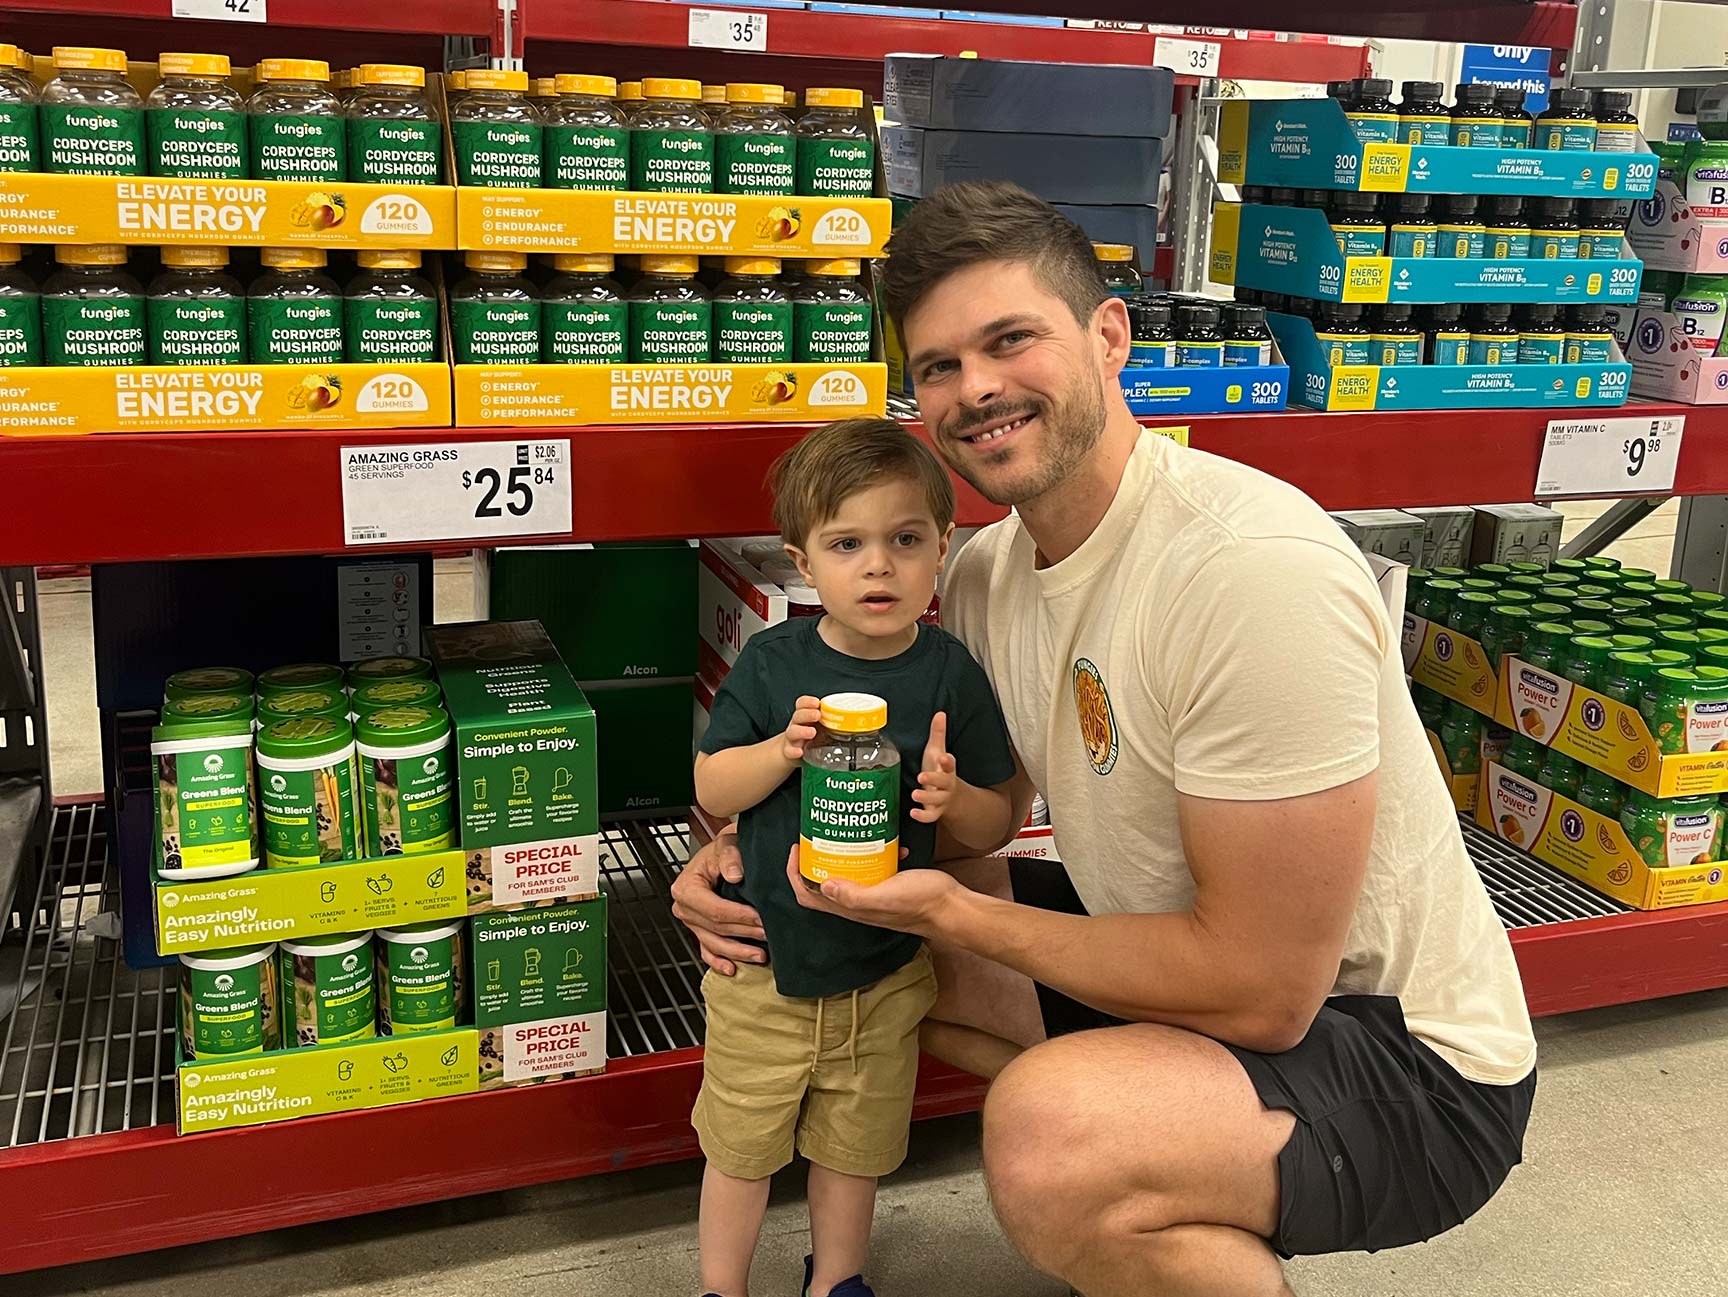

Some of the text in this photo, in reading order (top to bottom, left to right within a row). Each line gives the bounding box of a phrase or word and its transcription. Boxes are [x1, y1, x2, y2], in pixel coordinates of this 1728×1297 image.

[1522, 80, 1545, 94] this
[66, 115, 118, 130] fungies
[380, 127, 424, 142] fungies
[488, 130, 530, 145] fungies
[53, 137, 133, 152] CORDYCEPS
[662, 139, 702, 153] fungies
[52, 150, 136, 166] MUSHROOM
[366, 149, 435, 162] CORDYCEPS
[473, 152, 539, 165] CORDYCEPS
[1369, 156, 1402, 167] ENERGY
[364, 162, 437, 176] MUSHROOM
[471, 164, 540, 178] MUSHROOM
[648, 159, 710, 171] CORDYCEPS
[1369, 165, 1401, 175] HEALTH
[1496, 164, 1530, 175] VITAMIN
[1628, 163, 1653, 179] 300
[646, 171, 711, 184] MUSHROOM
[117, 184, 266, 202] ELEVATE YOUR
[1625, 182, 1650, 192] TABLETS
[375, 202, 417, 220] 120
[614, 200, 737, 217] ELEVATE YOUR
[118, 203, 267, 231] ENERGY
[824, 214, 860, 232] 120
[376, 222, 418, 231] GUMMIES
[614, 217, 736, 242] ENERGY
[825, 234, 859, 242] GUMMIES
[1350, 268, 1383, 278] ENERGY
[1479, 273, 1513, 282] VITAMIN
[1610, 268, 1637, 283] 300
[1350, 277, 1382, 287] HEALTH
[1609, 287, 1634, 296] TABLETS
[81, 306, 130, 322] fungies
[656, 310, 698, 324] fungies
[67, 329, 142, 341] CORDYCEPS
[644, 330, 707, 341] CORDYCEPS
[65, 340, 144, 354] MUSHROOM
[642, 341, 708, 353] MUSHROOM
[116, 373, 262, 388] ELEVATE YOUR
[611, 370, 732, 384] ELEVATE YOUR
[1467, 380, 1500, 388] VITAMIN
[1600, 372, 1627, 386] 300
[371, 382, 412, 398] 120
[821, 377, 855, 393] 120
[1252, 382, 1281, 397] 300
[611, 386, 732, 409] ENERGY
[1598, 391, 1623, 399] TABLETS
[118, 390, 263, 417] ENERGY
[1552, 426, 1564, 434] MM
[1600, 424, 1606, 432] C
[348, 450, 458, 464] AMAZING GRASS
[535, 446, 556, 458] $2.06
[349, 462, 434, 472] GREEN SUPERFOOD
[360, 471, 404, 479] SERVINGS
[716, 604, 742, 652] goli
[476, 664, 543, 675] Nutritious
[488, 668, 535, 678] Greens
[623, 665, 658, 675] Alcon
[485, 678, 548, 689] Supports
[487, 683, 551, 694] Digestive
[1522, 672, 1556, 693] vitafusion
[499, 688, 544, 698] Health
[1518, 682, 1558, 709] Power C
[507, 704, 551, 714] Based
[508, 700, 545, 708] Plant
[1696, 704, 1727, 713] vitafusion
[1689, 718, 1722, 730] Power
[474, 726, 568, 742] Convenient Powder.
[464, 737, 579, 758] Simple to Enjoy.
[1680, 764, 1705, 773] VITAMIN
[826, 777, 874, 793] fungies
[1501, 779, 1534, 800] vitafusion
[182, 785, 245, 800] Greens Blend
[552, 793, 574, 801] Bake.
[196, 800, 236, 809] SUPERFOOD
[508, 798, 533, 806] Blend.
[626, 796, 660, 807] Alcon
[813, 797, 887, 813] CORDYCEPS
[1497, 789, 1537, 817] Power C
[285, 805, 313, 815] Blend
[811, 809, 888, 826] MUSHROOM
[1676, 818, 1707, 827] vitafusion
[825, 829, 873, 838] GUMMIES
[1670, 829, 1711, 843] Power C
[505, 844, 582, 865] SPECIAL
[516, 862, 571, 878] PRICE
[812, 867, 828, 878] 120
[508, 876, 580, 890] FOR SAM'S CLUB
[522, 884, 566, 896] MEMBERS
[182, 888, 256, 904] Amazing Grass
[415, 896, 457, 905] NUTRITIOUS
[165, 906, 258, 929] Amazingly
[310, 910, 346, 919] VITAMINS
[489, 908, 579, 926] Convenient Powder.
[166, 916, 295, 945] Easy Nutrition
[479, 920, 590, 942] Simple to Enjoy.
[392, 971, 450, 986] Greens Blend
[196, 999, 258, 1013] Greens Blend
[515, 1021, 591, 1042] SPECIAL
[526, 1037, 580, 1055] PRICE
[518, 1051, 587, 1066] FOR SAM'S CLUB
[532, 1060, 574, 1072] MEMBERS
[204, 1066, 276, 1084] Amazing Grass
[186, 1086, 276, 1109] Amazingly
[186, 1095, 312, 1123] Easy Nutrition
